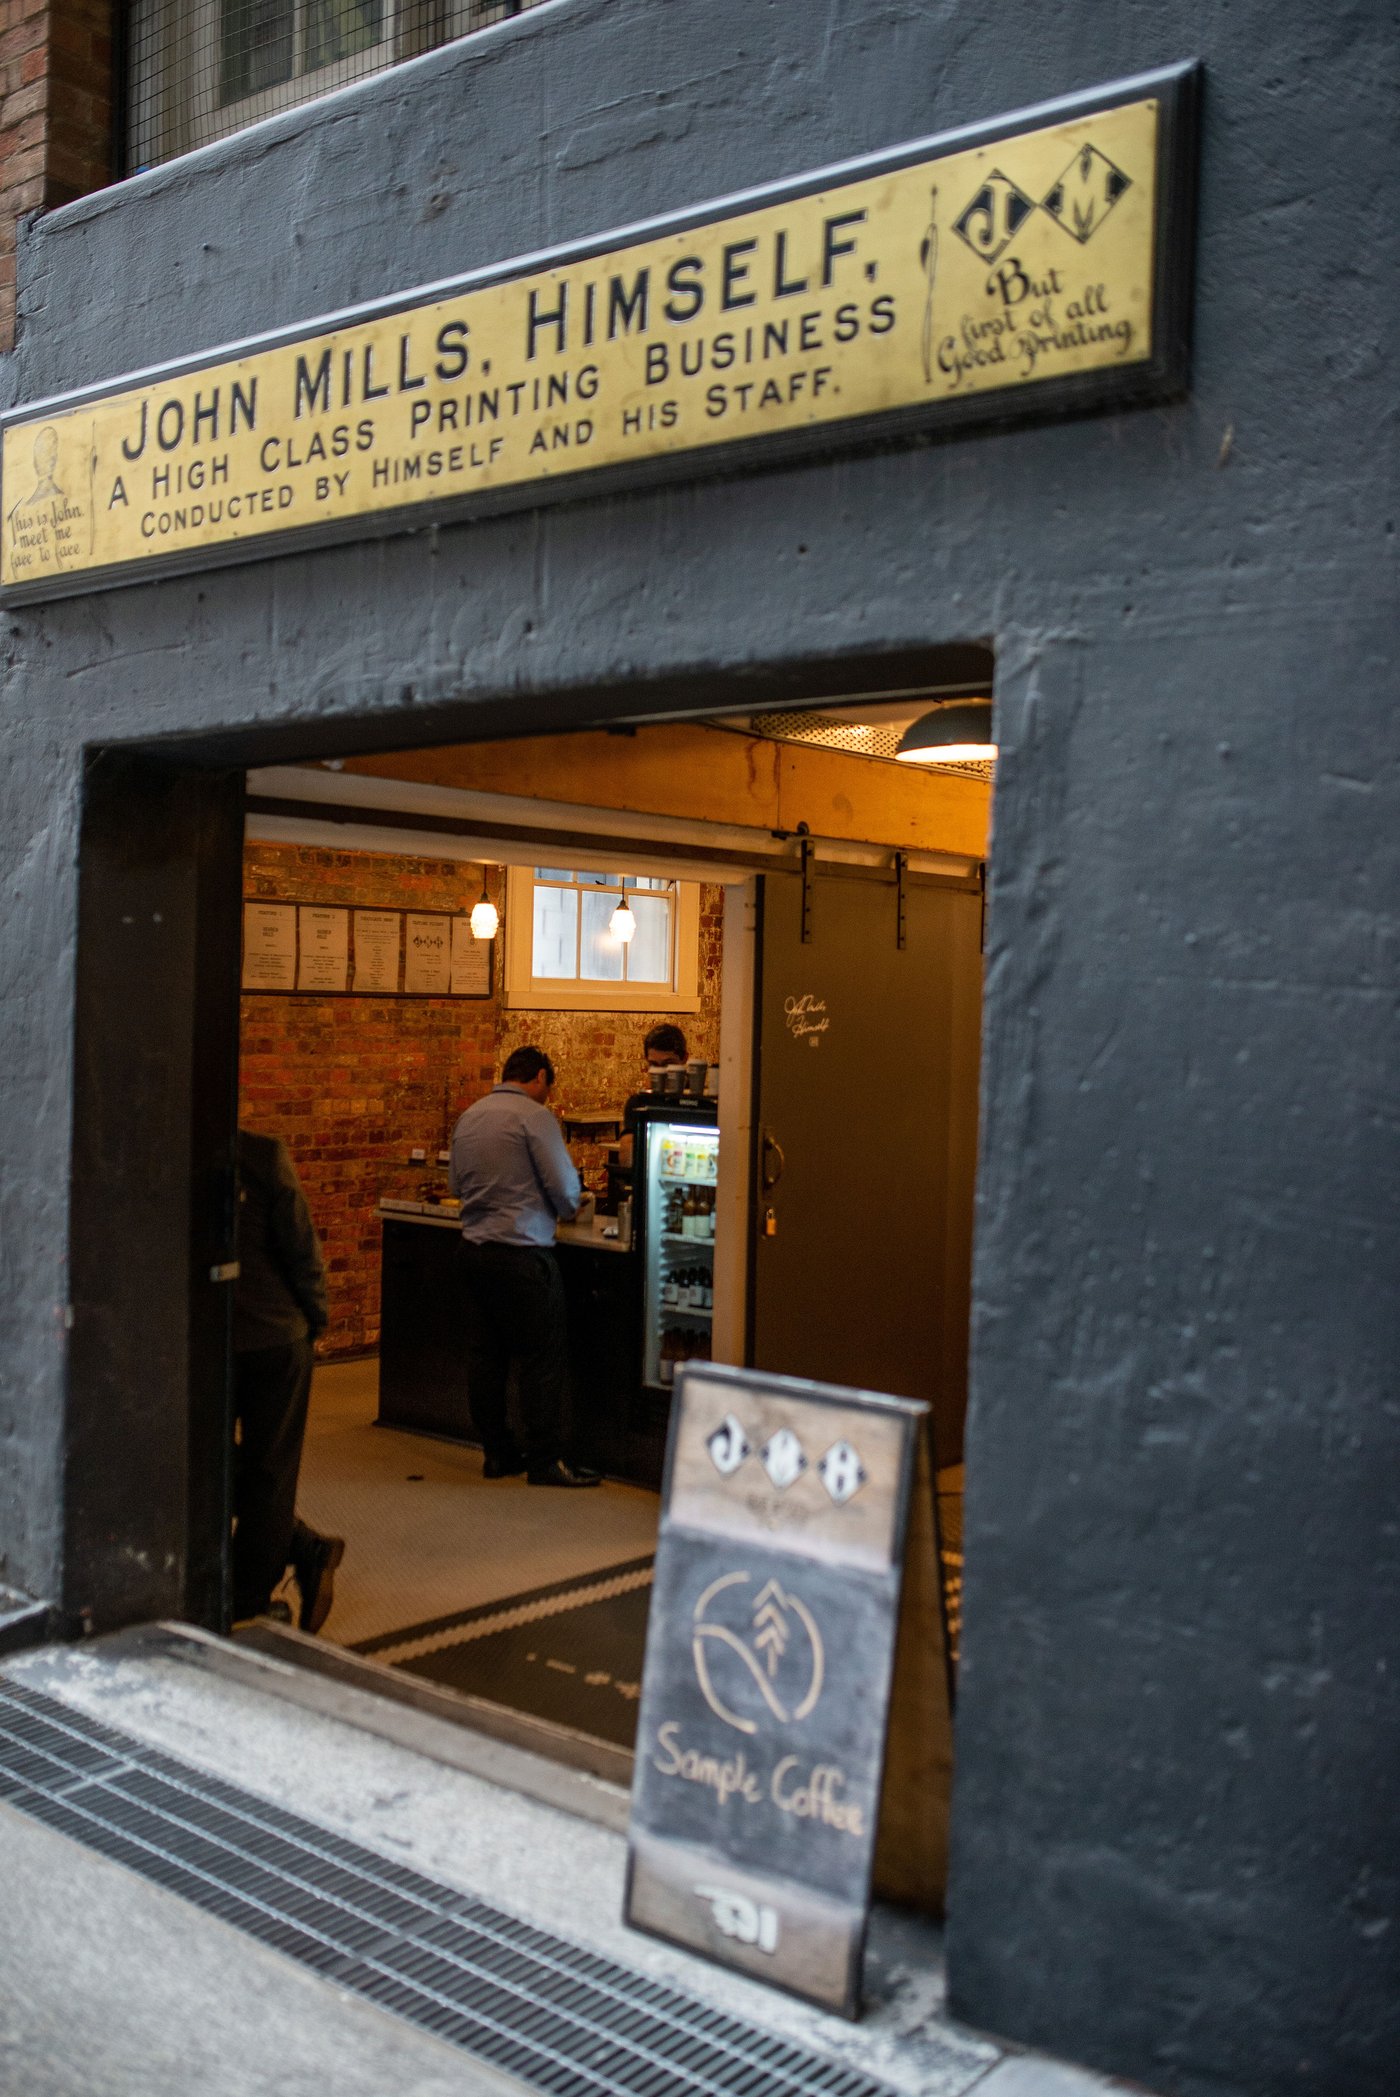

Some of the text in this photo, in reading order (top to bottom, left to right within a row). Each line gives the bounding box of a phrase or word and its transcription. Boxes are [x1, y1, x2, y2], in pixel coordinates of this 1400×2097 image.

[985, 257, 1063, 305] But
[960, 283, 1110, 351] first of all
[937, 334, 1006, 389] Good
[107, 294, 897, 511] A HIGH CLASS PRINTING BUSINESS
[121, 376, 258, 462] JOHN
[140, 366, 843, 538] CONDUCTED BY HIMSELF AND HIS STAFF.
[7, 497, 33, 546] This
[36, 512, 48, 527] is
[19, 526, 71, 549] meet me
[10, 551, 32, 579] face
[40, 547, 50, 562] to
[653, 1720, 864, 1836] Sample Coffee
